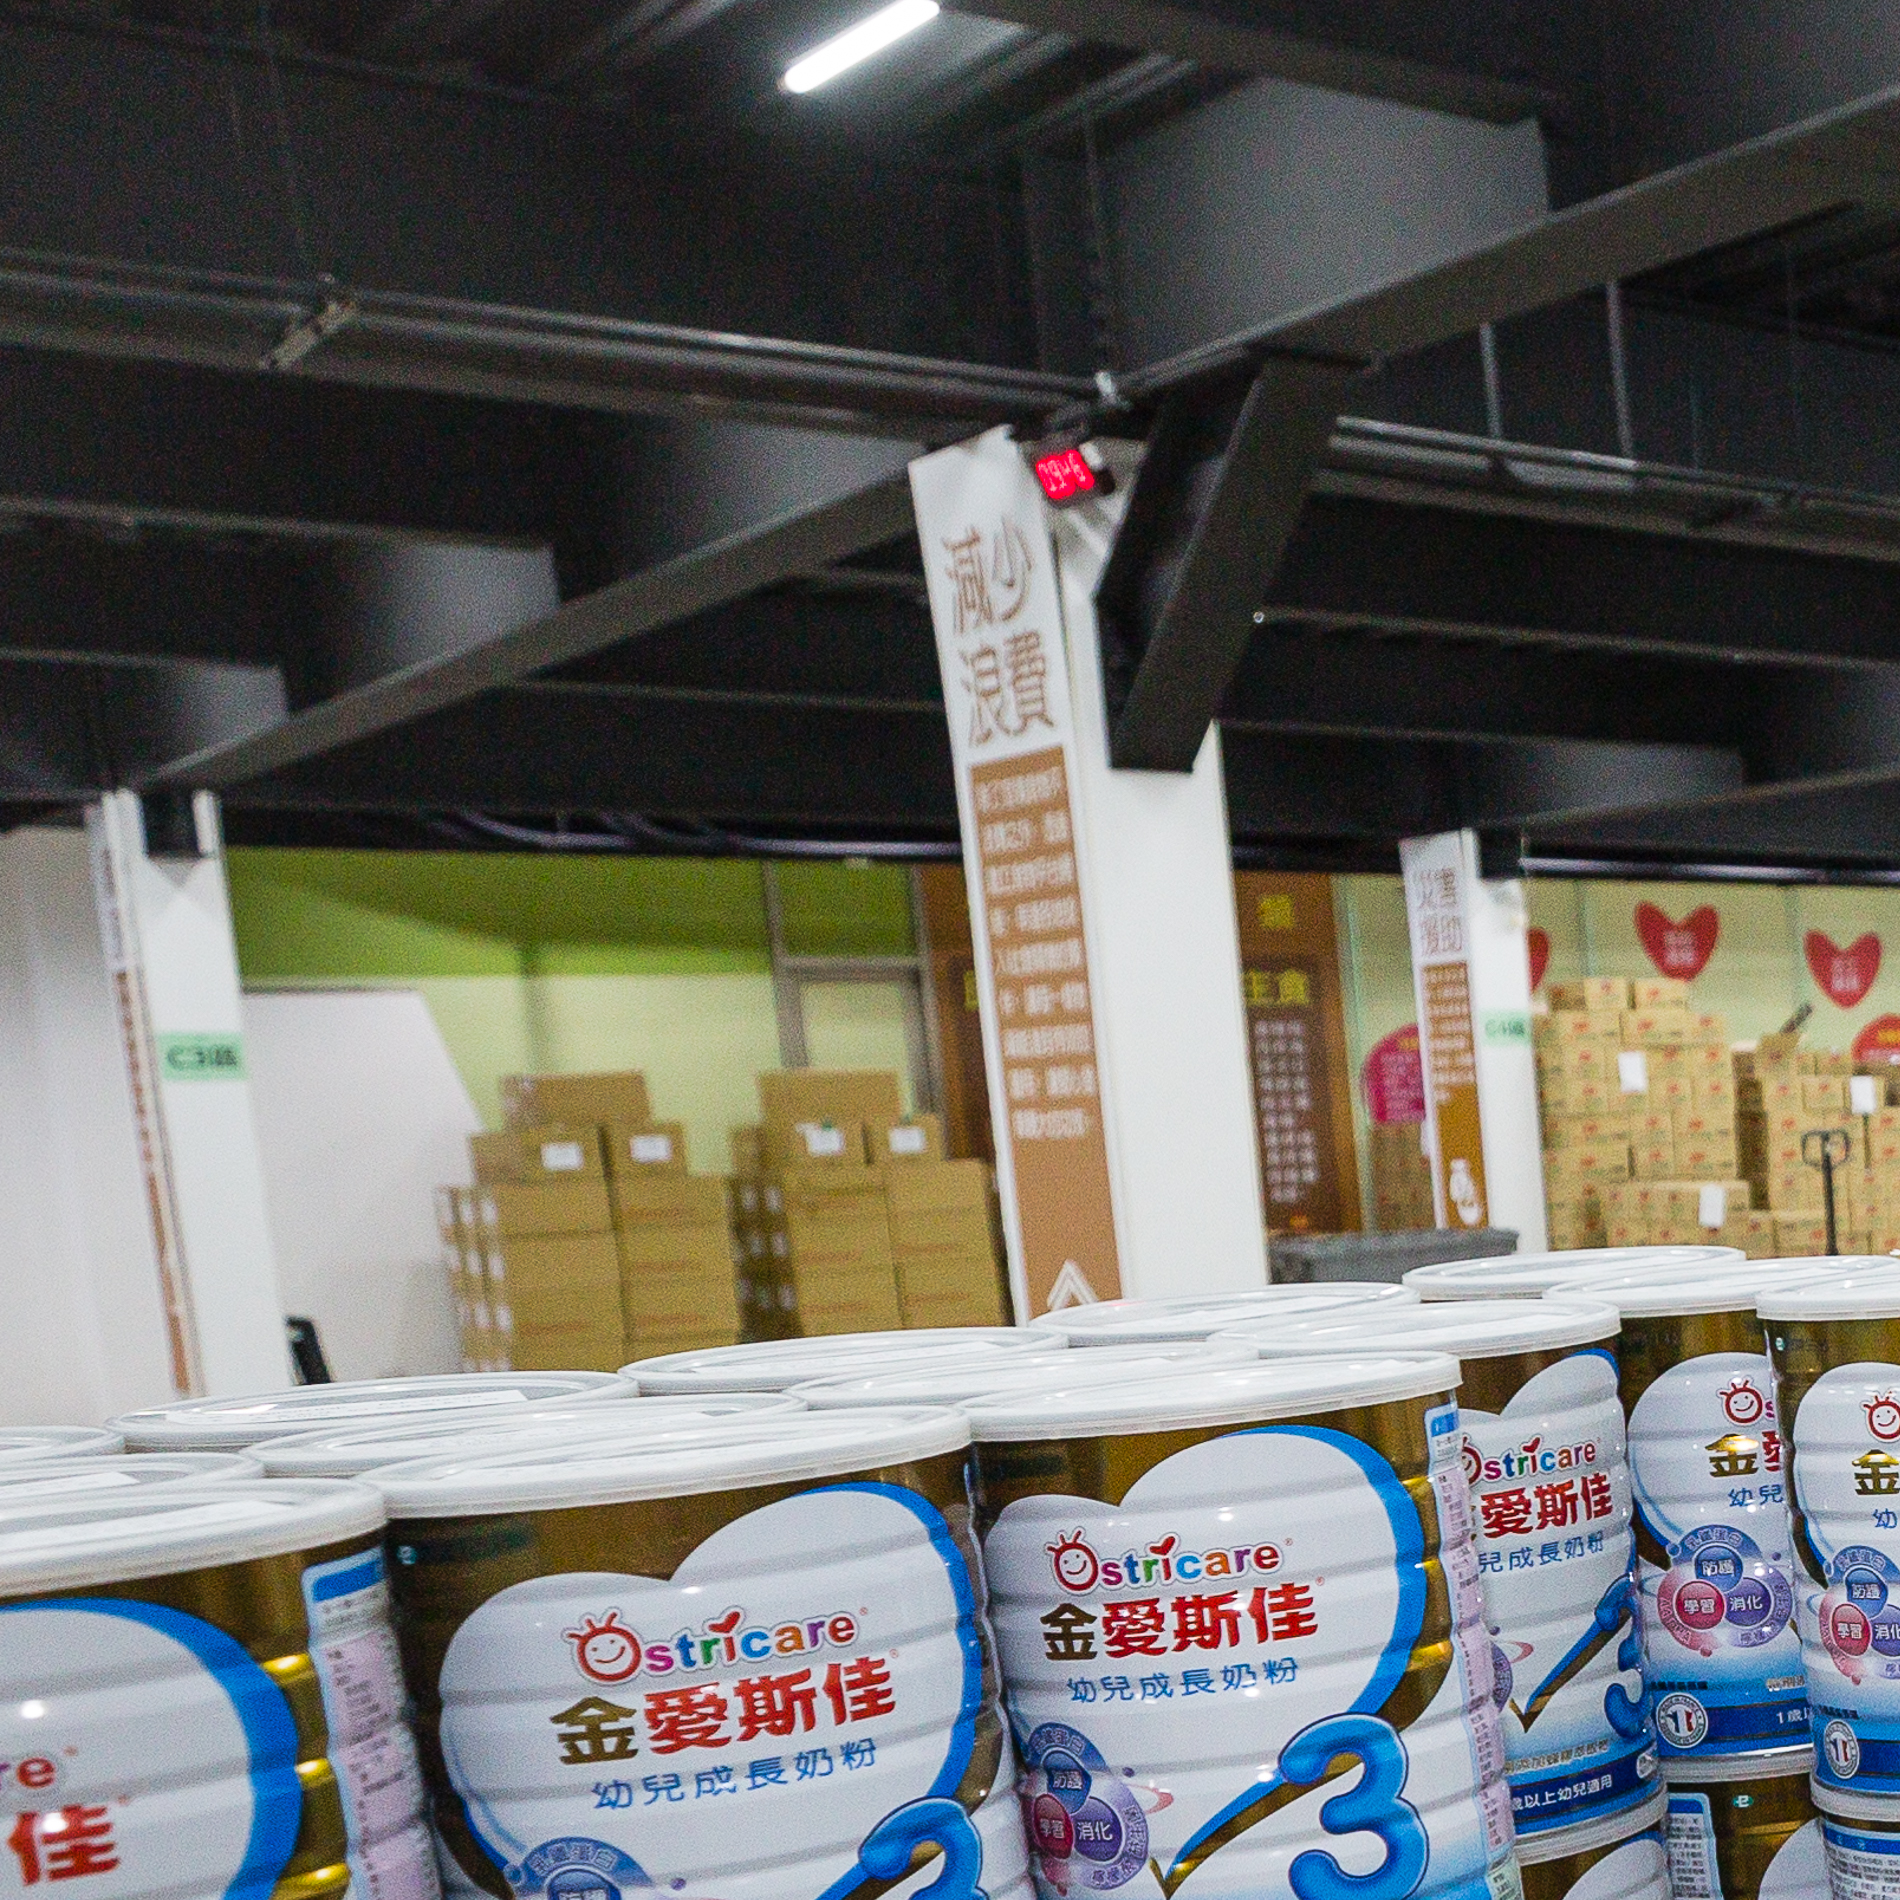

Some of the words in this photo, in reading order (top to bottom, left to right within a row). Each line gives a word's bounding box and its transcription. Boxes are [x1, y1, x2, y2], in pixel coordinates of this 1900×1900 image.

[1046, 1528, 1280, 1592] Ostricare
[563, 1607, 856, 1683] Ostricare
[1040, 1582, 1319, 1661] 金愛斯佳
[550, 1656, 897, 1766] 金愛斯佳
[1067, 1657, 1297, 1704] 幼兒成長奶粉
[592, 1738, 877, 1811] 幼兒成長奶粉
[1078, 1818, 1113, 1842] 消化
